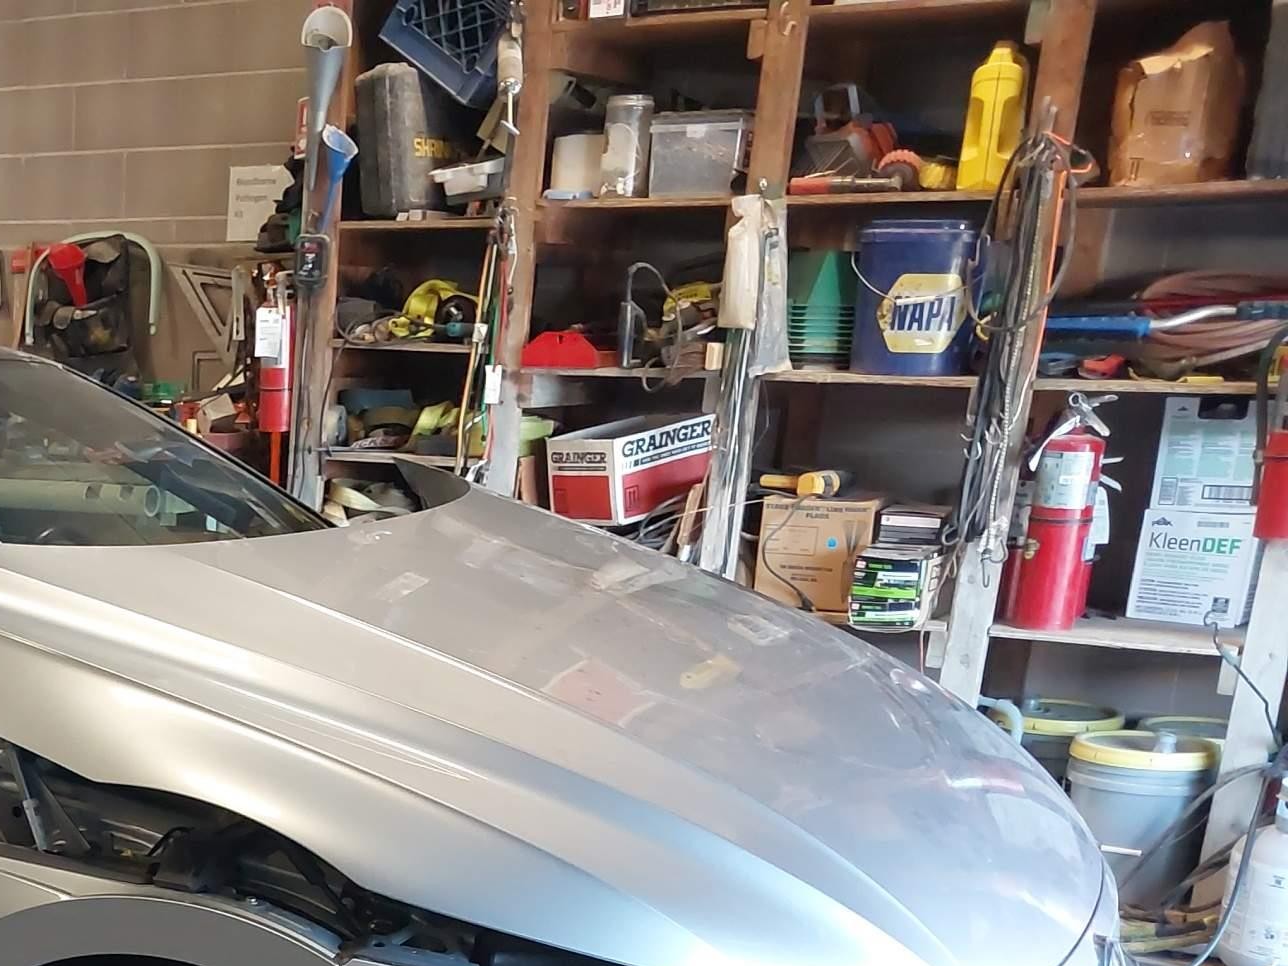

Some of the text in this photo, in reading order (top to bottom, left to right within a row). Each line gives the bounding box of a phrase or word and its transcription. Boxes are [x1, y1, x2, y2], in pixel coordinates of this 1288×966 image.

[890, 295, 956, 331] NAPA
[622, 419, 712, 459] GRAINGER
[551, 452, 607, 464] GRAINGER
[1149, 531, 1242, 555] KleenDEF
